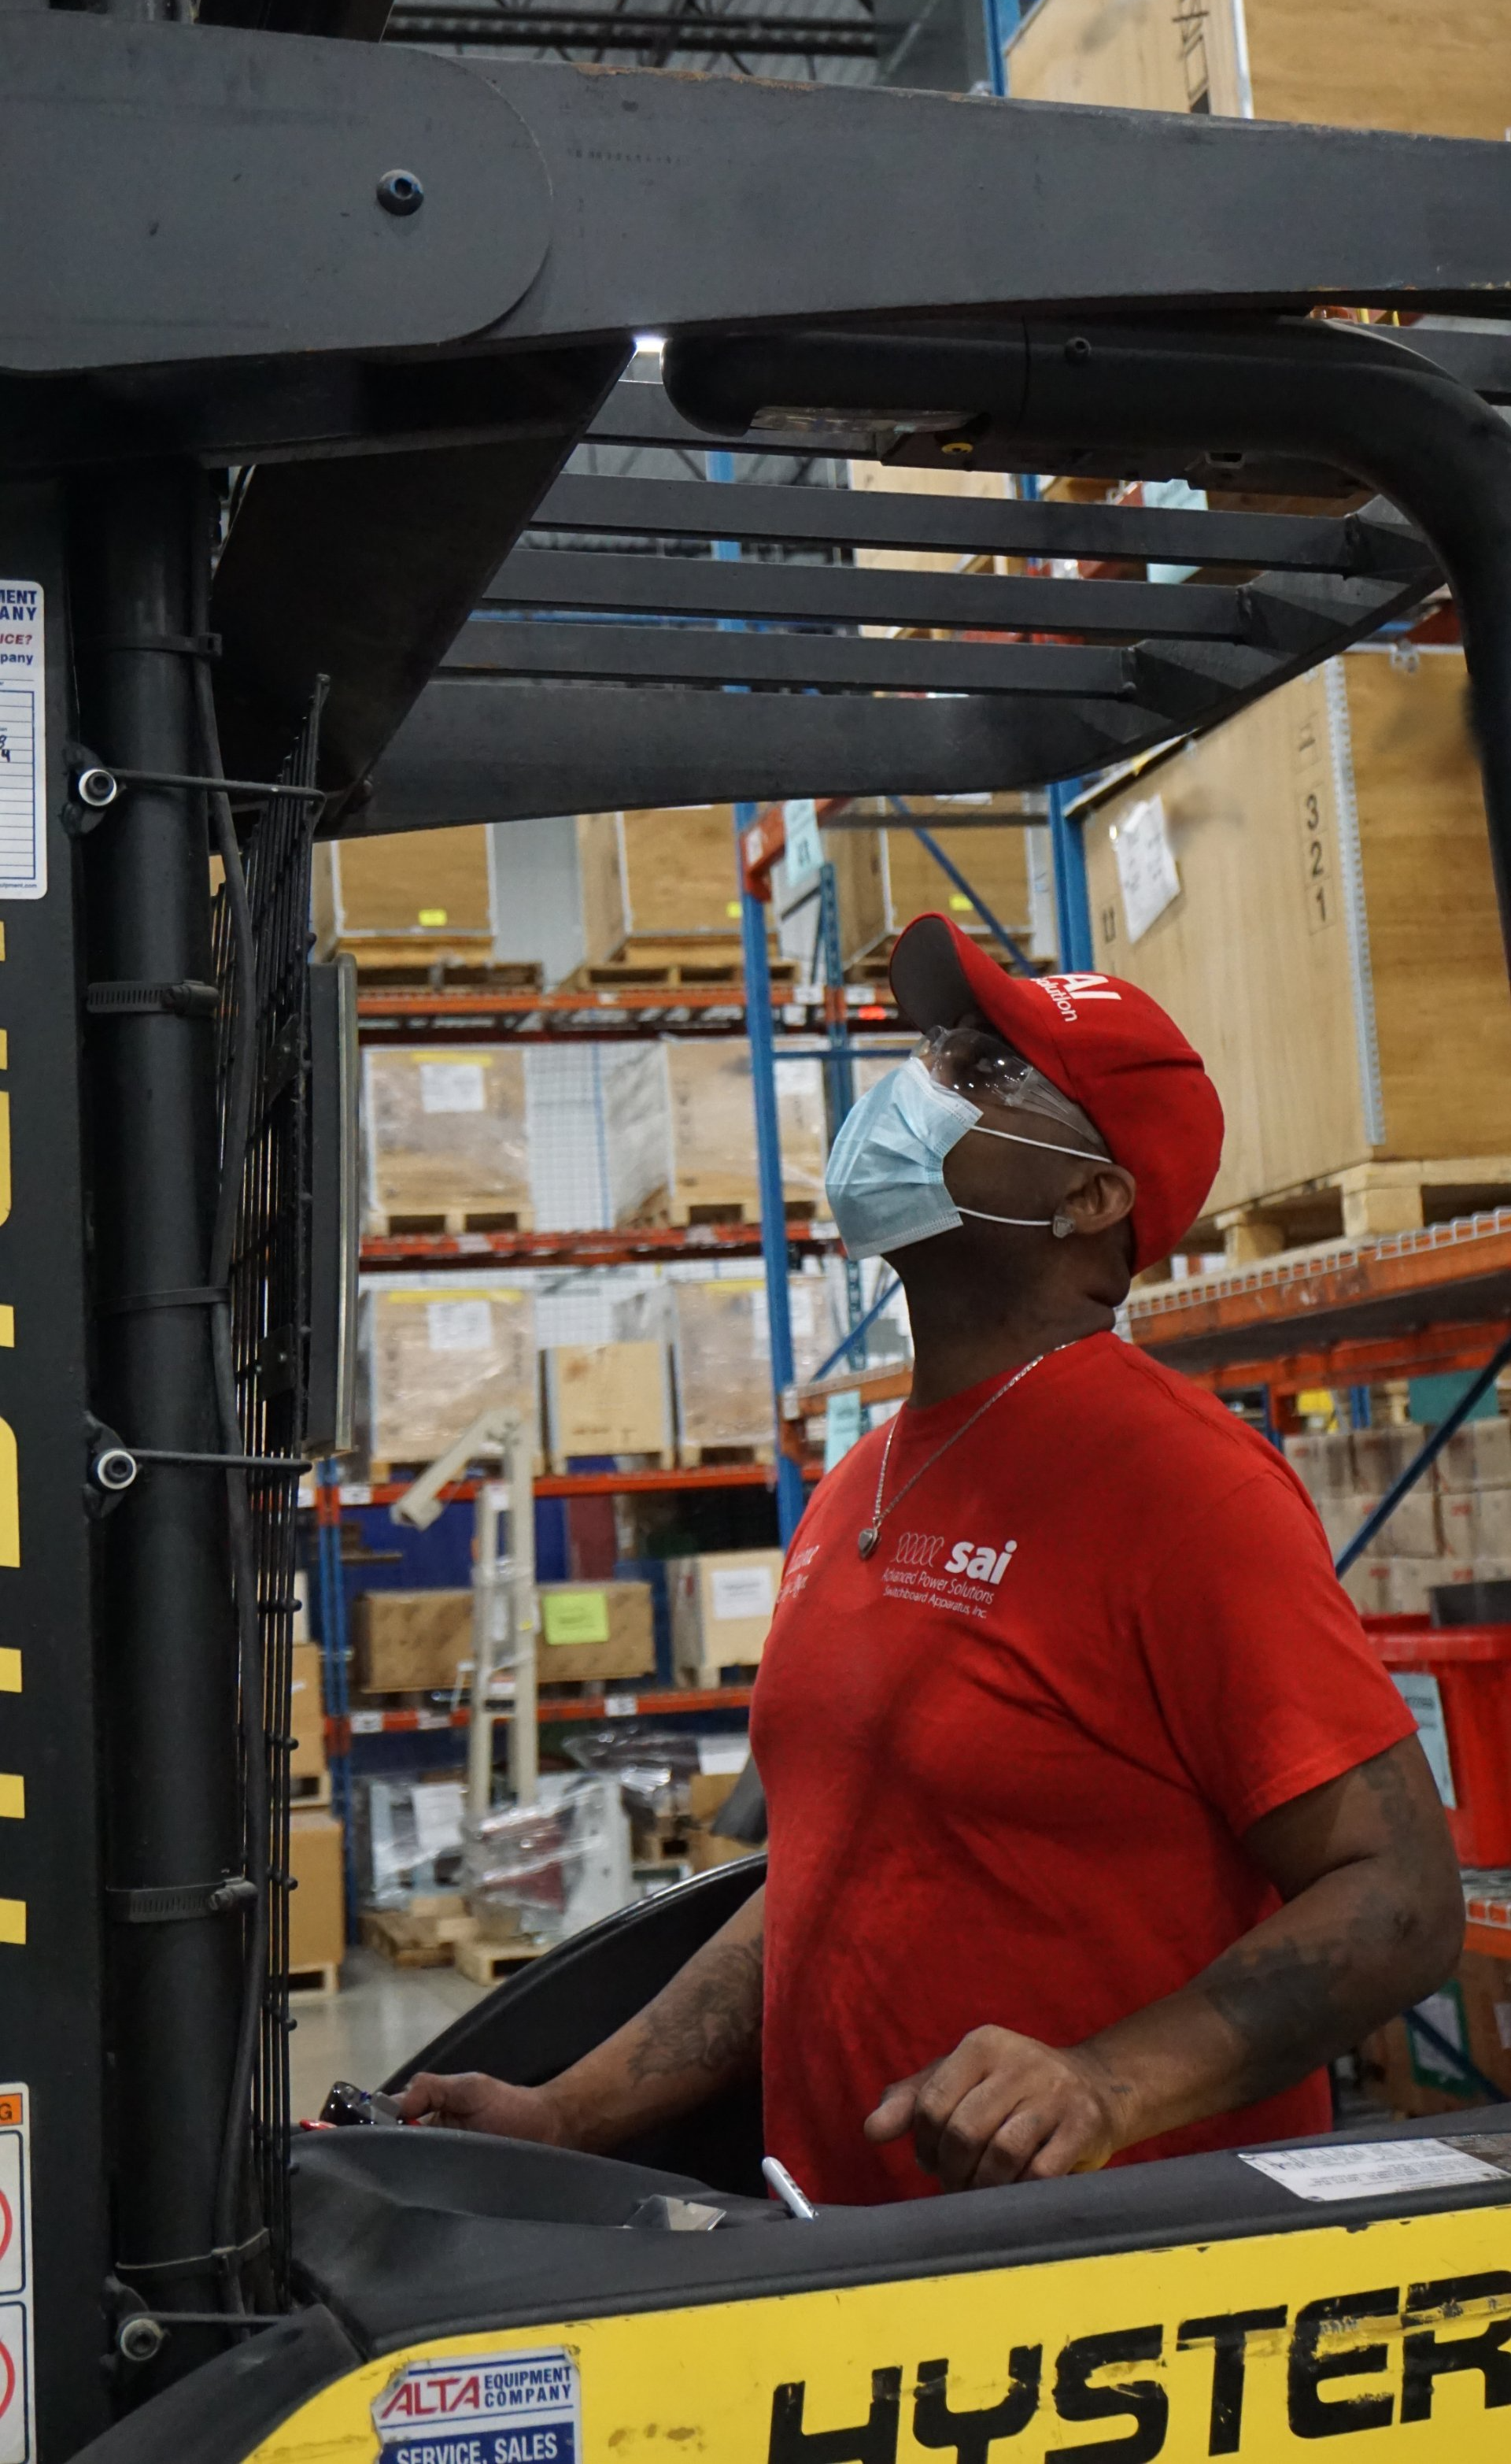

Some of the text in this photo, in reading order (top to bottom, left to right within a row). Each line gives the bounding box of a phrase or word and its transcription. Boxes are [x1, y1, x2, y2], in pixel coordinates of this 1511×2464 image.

[1306, 794, 1326, 922] 3 2 1
[1048, 974, 1122, 1000] AI
[944, 1540, 1018, 1585] sai
[881, 1567, 995, 1605] Advanced Power Solutions
[883, 1585, 929, 1603] Switchboard
[768, 2270, 1511, 2464] HYSTER
[381, 2366, 572, 2420] ALTA EQUIPMENT
[484, 2384, 571, 2409] COMPANY
[495, 2432, 558, 2464] SALES
